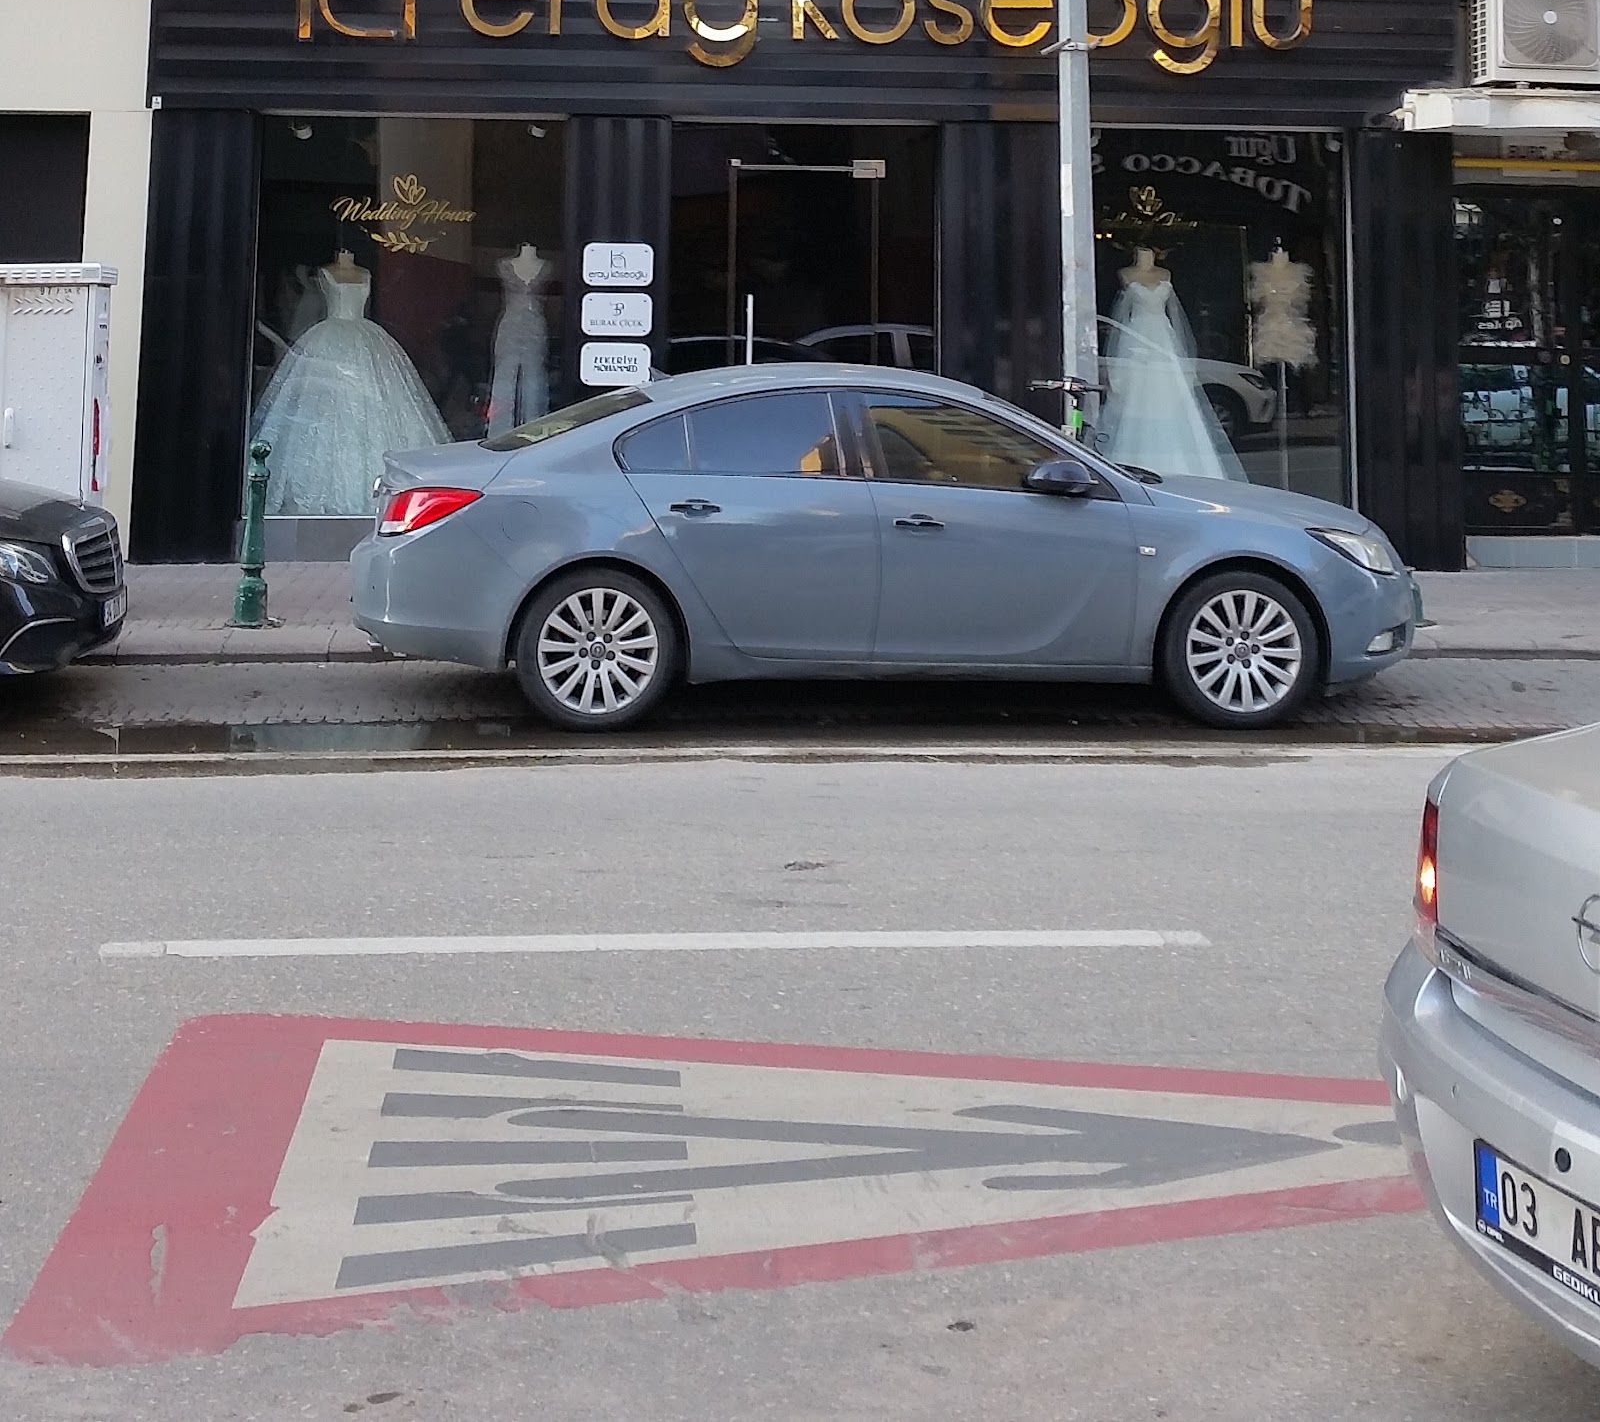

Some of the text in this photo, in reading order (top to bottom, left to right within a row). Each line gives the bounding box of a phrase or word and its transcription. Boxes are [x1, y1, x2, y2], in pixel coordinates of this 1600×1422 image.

[330, 195, 478, 230] Wedding House
[588, 271, 609, 280] eray
[590, 319, 617, 327] BURAK
[593, 364, 638, 373] MOHAMMED
[1483, 1188, 1499, 1210] TR
[1501, 1171, 1538, 1238] 03
